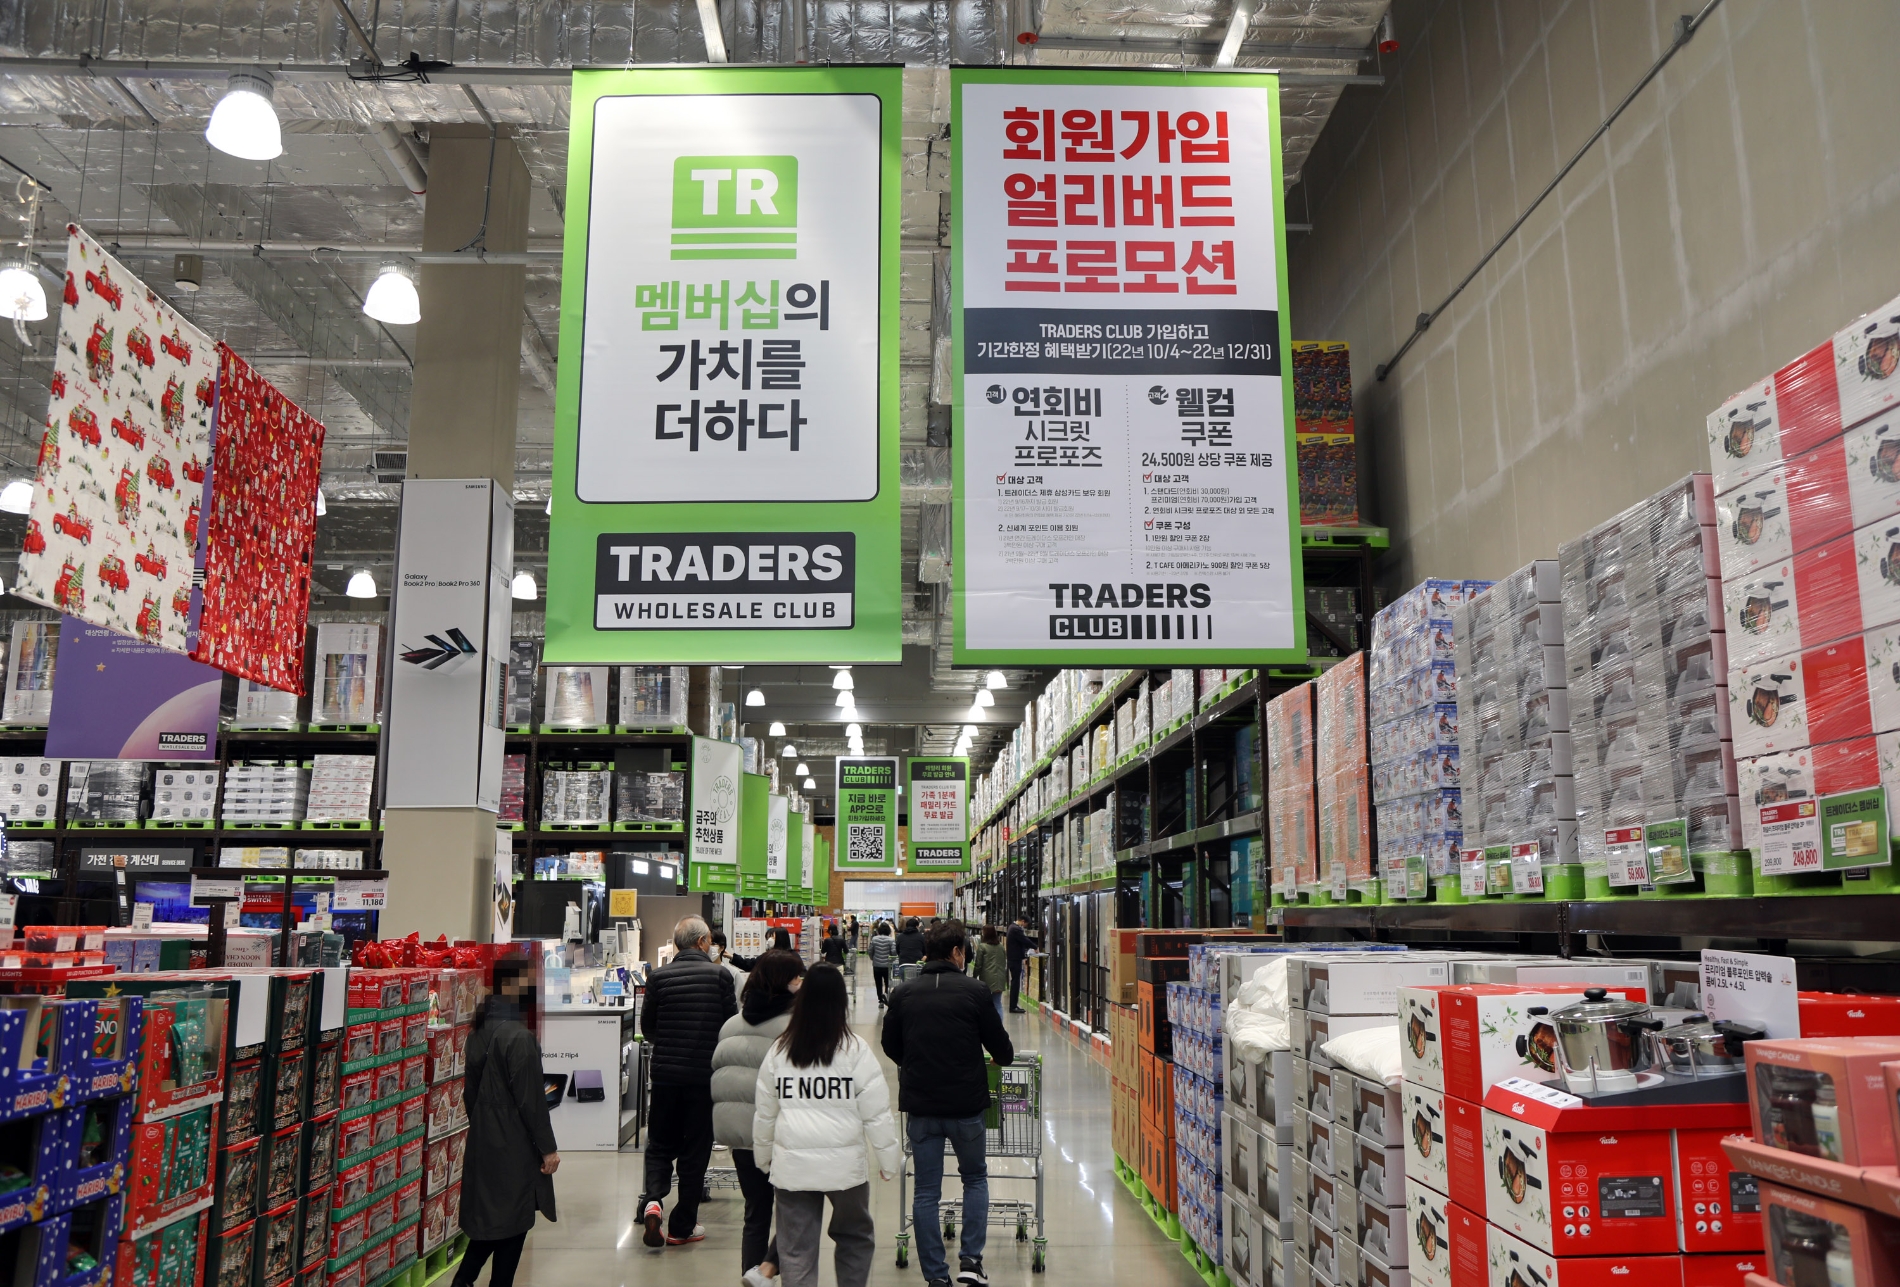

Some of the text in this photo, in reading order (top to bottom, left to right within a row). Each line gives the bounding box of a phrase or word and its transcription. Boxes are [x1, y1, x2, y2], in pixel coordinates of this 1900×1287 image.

[1003, 106, 1230, 164] 회원가입
[691, 168, 779, 215] TR
[1003, 173, 1235, 228] 얼리버드
[1005, 239, 1238, 295] 프로모션
[635, 279, 830, 331] 멤버십의
[1039, 324, 1209, 341] TRADERS CLUB 가입하고
[977, 342, 1271, 361] 기간한정 혜택받기(22년 10/4~22년 12/31)
[655, 339, 806, 391] 가치를
[1012, 386, 1101, 417] 연회비
[1176, 388, 1234, 417] 웰컴
[655, 399, 807, 452] 더하다
[1025, 420, 1090, 442] 시크릿
[1181, 421, 1232, 447] 쿠폰
[1014, 446, 1102, 467] 프로포즈
[1142, 452, 1273, 468] 24,500원 상당 쿠폰 제공
[1008, 476, 1043, 485] 대상 고객
[1154, 475, 1189, 483] 대상 고객
[1004, 489, 1038, 497] 트레이더스
[1156, 522, 1191, 530] 쿠폰 구성
[610, 544, 843, 582] TRADERS
[1049, 583, 1212, 609] TRADERS
[614, 601, 836, 621] WHOLESALE CLUB
[1055, 618, 1124, 637] CLUB
[162, 734, 206, 742] TRADERS
[844, 766, 892, 774] TRADERS
[848, 794, 886, 803] 지금 바로
[922, 791, 936, 800] 가족
[850, 805, 884, 814] APP으로
[920, 801, 957, 810] 패밀리 카드
[1825, 803, 1858, 818] 트레이더스
[696, 810, 716, 826] 금주의
[924, 811, 954, 820] 무료 발급
[696, 827, 724, 844] 추천상품
[1834, 828, 1845, 836] TRA
[87, 854, 106, 866] 가전
[130, 854, 160, 866] 계산대
[918, 850, 960, 858] TRADERS
[1793, 849, 1818, 867] 249,800
[1721, 956, 1730, 964] Fast
[1734, 958, 1748, 966] Simple
[1704, 964, 1772, 983] 프리미엄 블루포인트 압력솥
[1706, 976, 1746, 991] 콤비 2.5L 4.5L
[94, 1020, 118, 1034] SNO
[1777, 1051, 1800, 1062] CANDLE
[92, 1074, 118, 1091] HARIBO
[775, 1077, 853, 1100] HE NORT
[14, 1090, 48, 1110] HARIBO
[1743, 1156, 1842, 1192] YANKEE CANDLE
[76, 1178, 105, 1200] HARIBO
[0, 1202, 26, 1224] ARIBO
